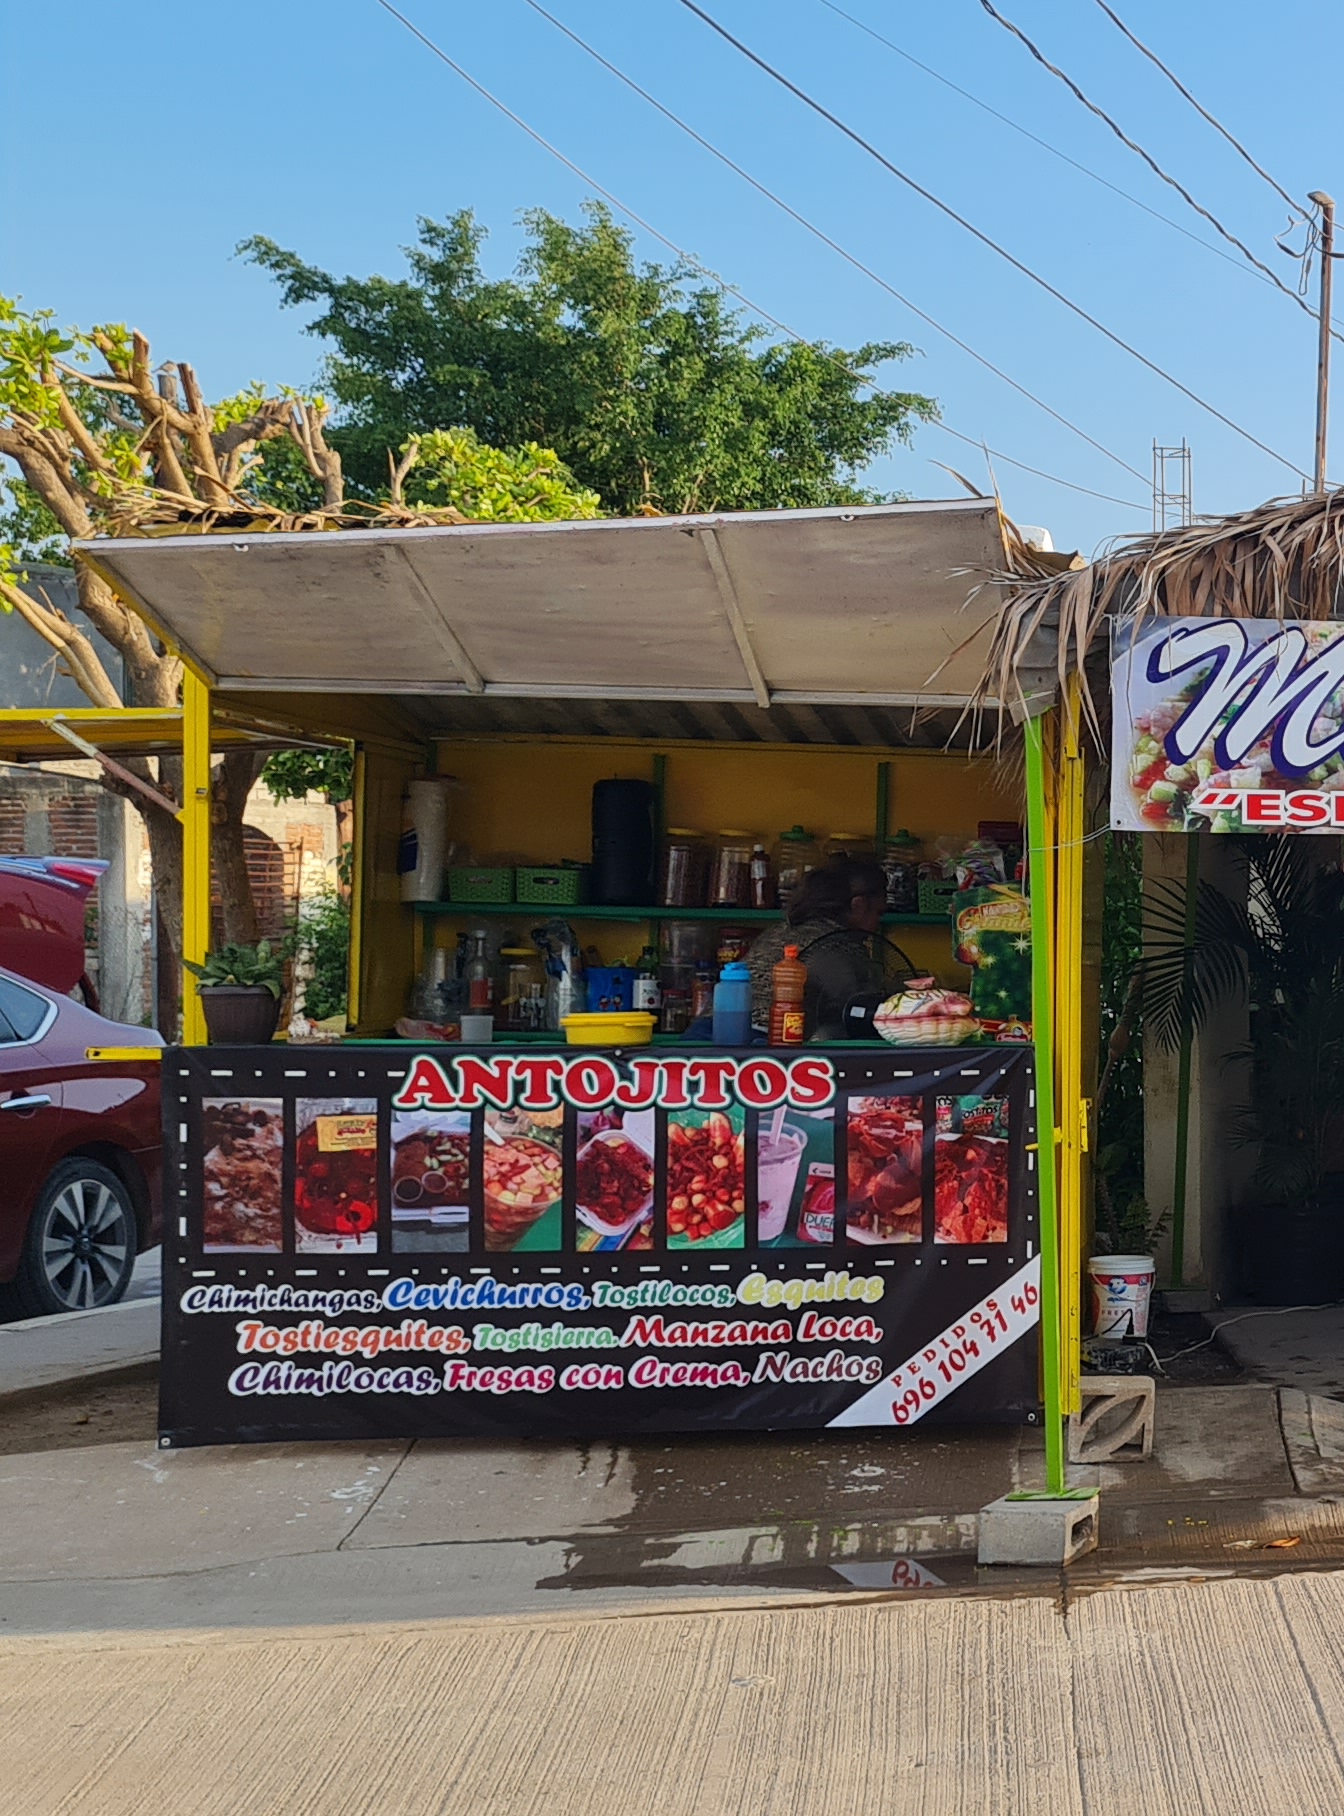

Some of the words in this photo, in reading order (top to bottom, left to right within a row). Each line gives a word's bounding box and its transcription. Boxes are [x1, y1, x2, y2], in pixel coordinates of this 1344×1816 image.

[394, 1056, 836, 1110] ANTOJITOS
[181, 1286, 383, 1316] Chimichangas,
[383, 1276, 592, 1311] Cevichurros,
[595, 1281, 736, 1309] Tostilocos,
[737, 1272, 884, 1309] Esquites
[237, 1320, 471, 1357] Tostiesquites,
[624, 1315, 794, 1348] Manzana
[798, 1312, 883, 1345] Loca,
[891, 1299, 998, 1387] PEDIDOS
[892, 1377, 936, 1424] 696
[938, 1339, 980, 1383] 104
[980, 1310, 1008, 1343] 71
[1011, 1281, 1038, 1315] 46
[229, 1361, 442, 1396] Chimilocas,
[444, 1360, 554, 1393] Fresas
[560, 1364, 624, 1389] con
[629, 1357, 751, 1387] Crema,
[753, 1350, 883, 1383] Nachos
